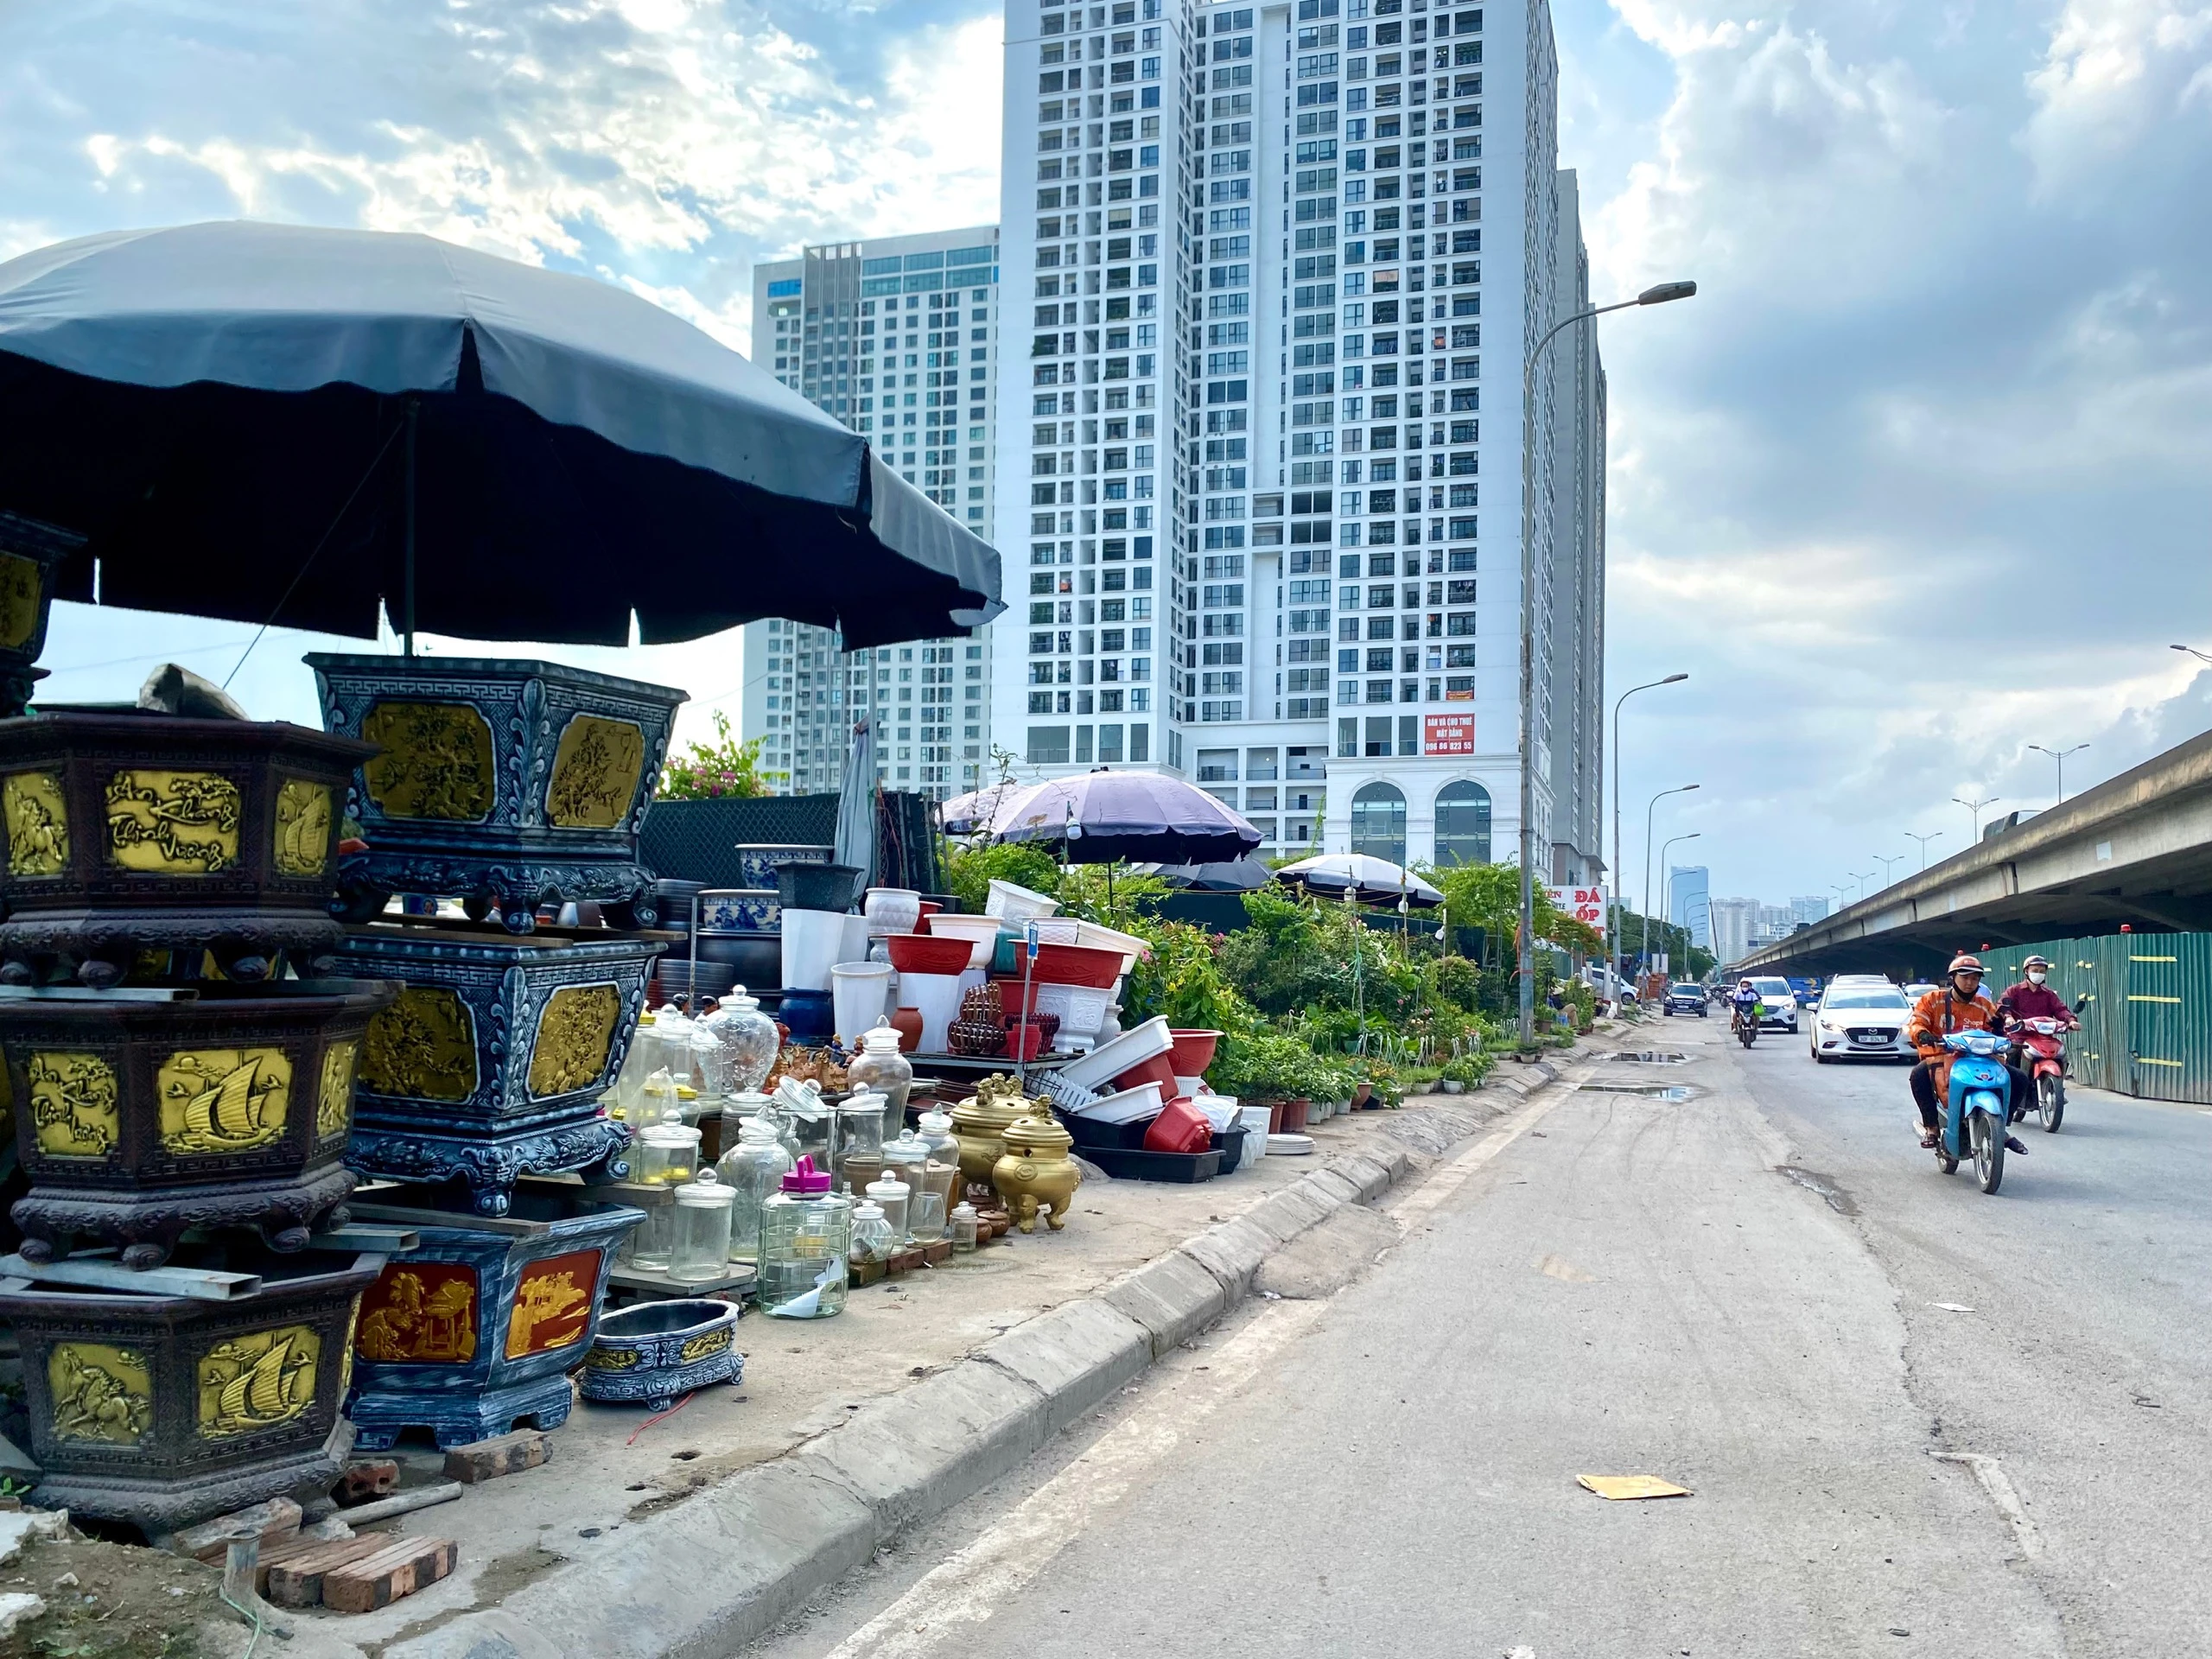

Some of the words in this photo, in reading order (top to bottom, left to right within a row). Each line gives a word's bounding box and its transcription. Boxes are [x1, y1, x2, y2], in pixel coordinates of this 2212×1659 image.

[1439, 716, 1446, 727] VÀ
[109, 776, 153, 804] An
[149, 798, 238, 832] Khang
[1574, 887, 1601, 903] ĐÁ
[1576, 904, 1599, 921] ỐP
